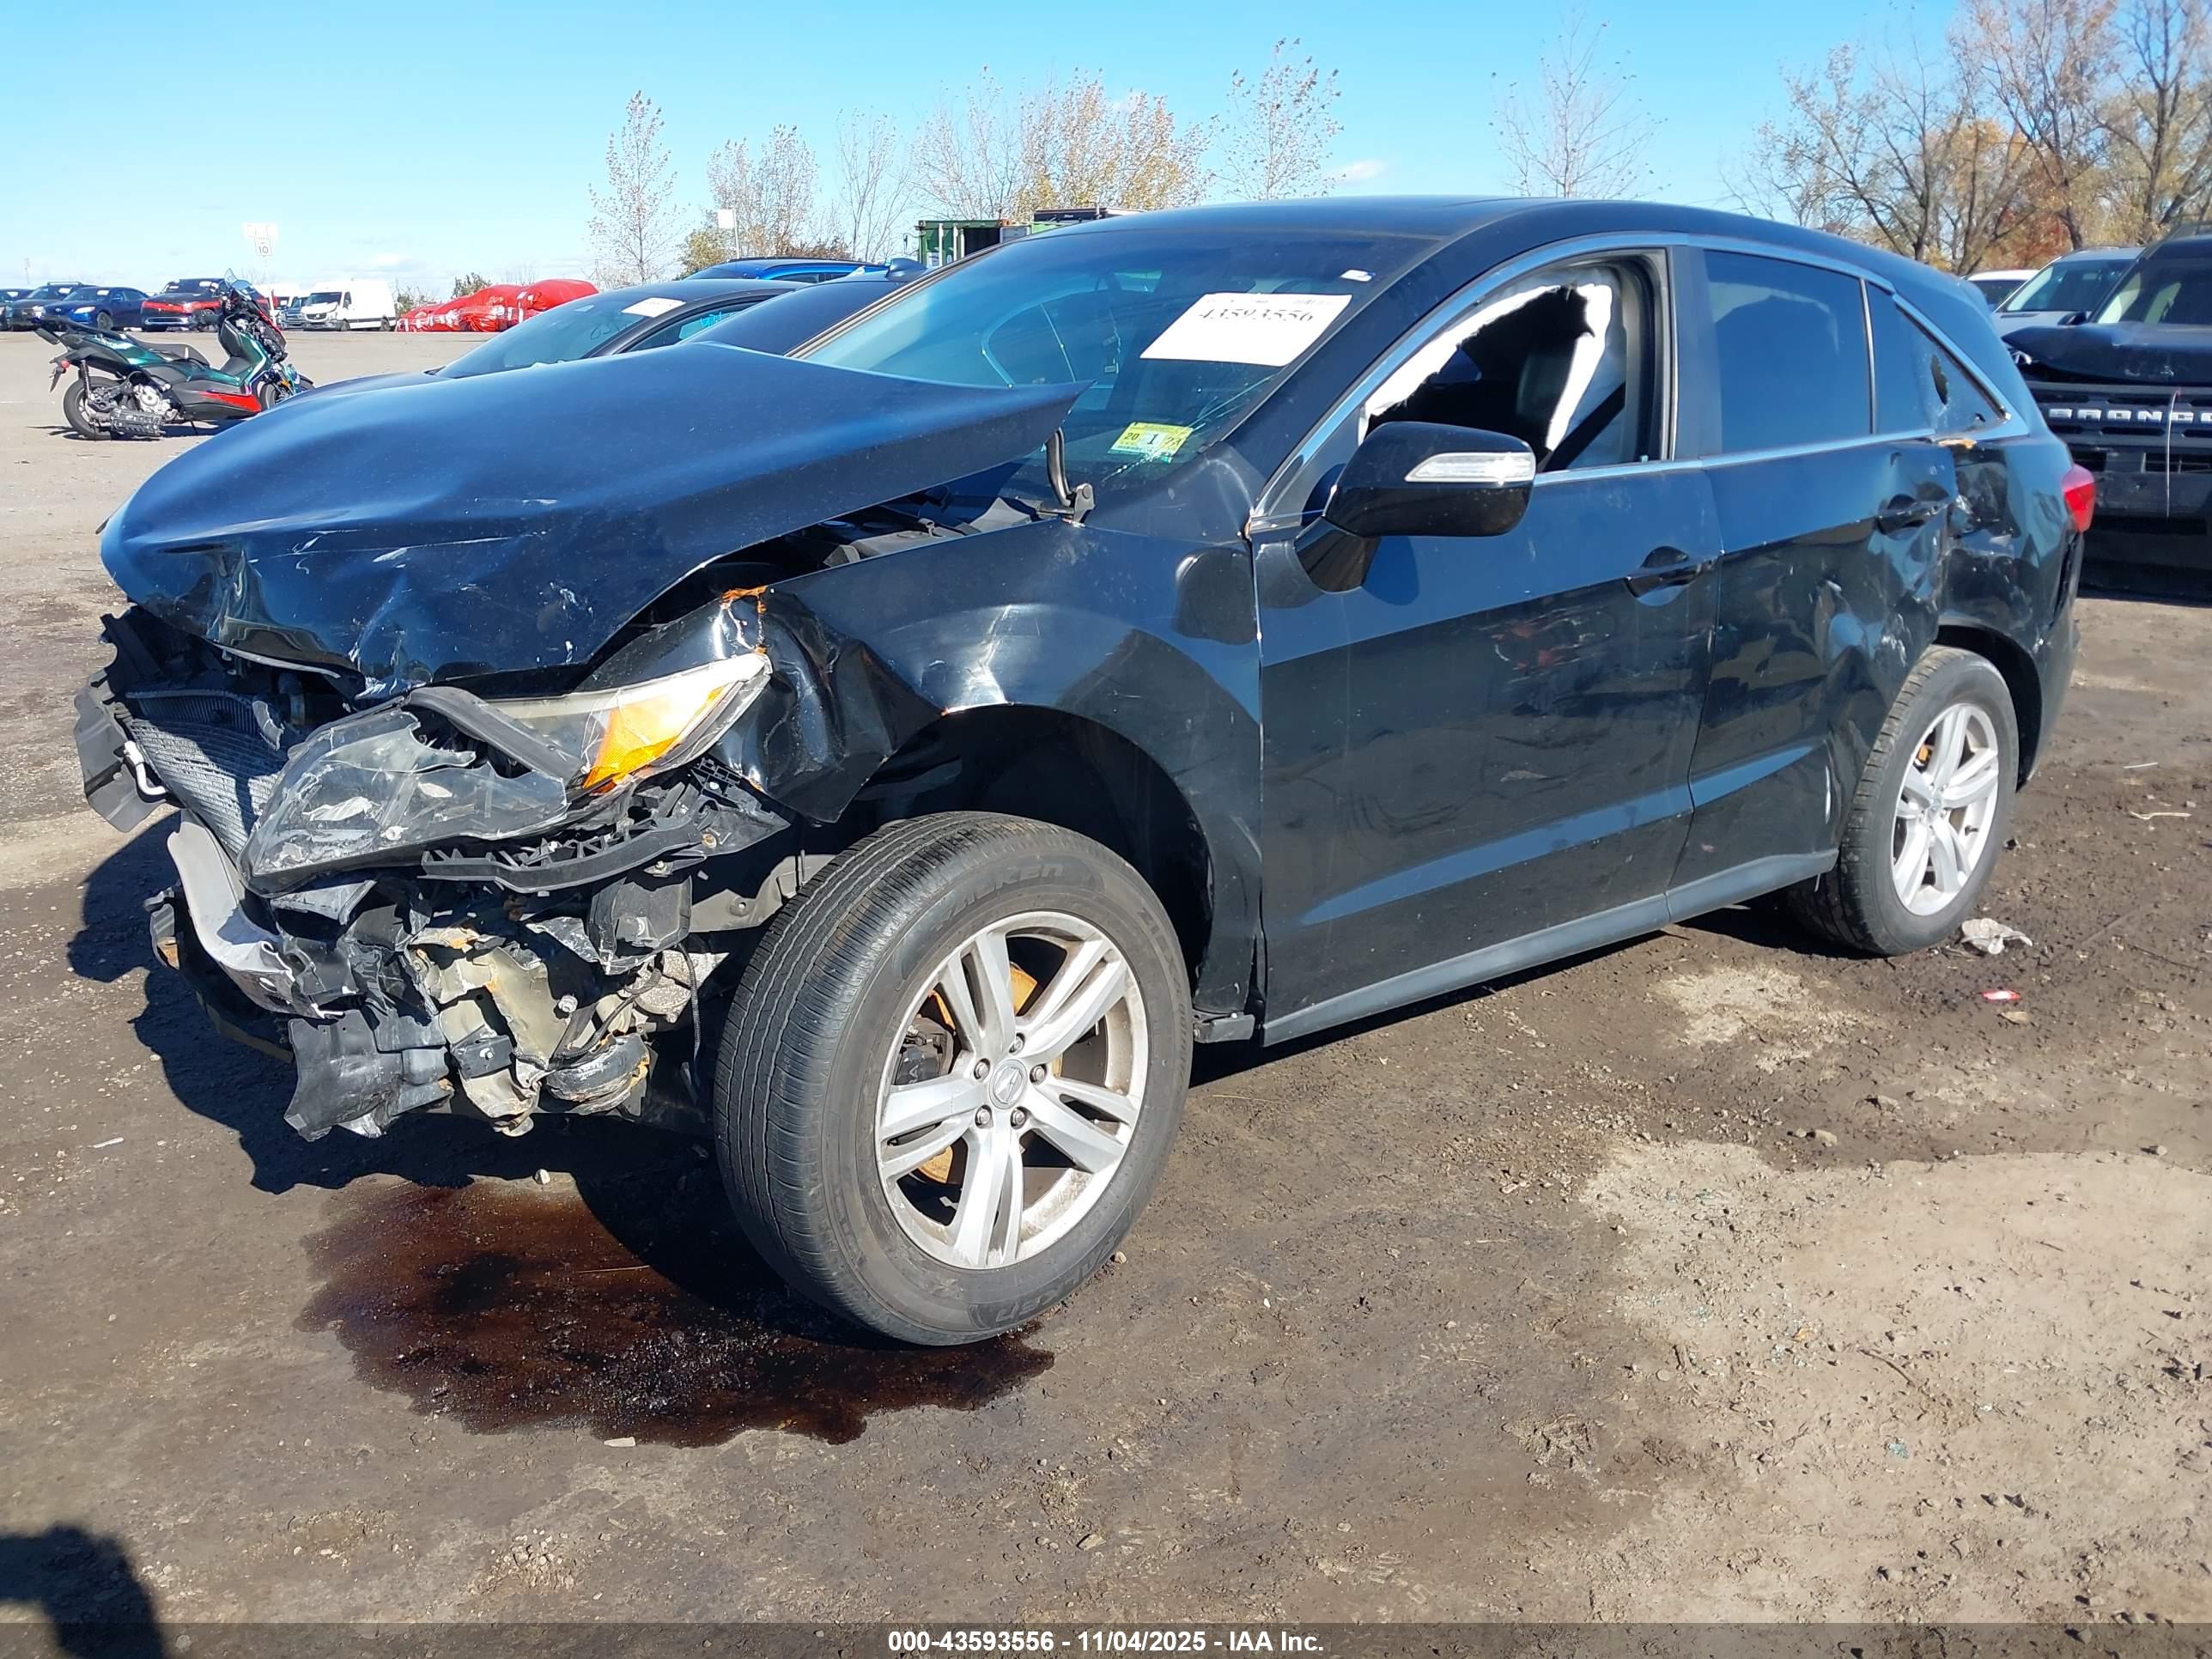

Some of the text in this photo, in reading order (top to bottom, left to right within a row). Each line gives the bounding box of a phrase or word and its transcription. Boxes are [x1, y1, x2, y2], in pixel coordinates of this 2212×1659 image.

[258, 246, 269, 254] 10
[1124, 432, 1140, 441] 20
[1146, 433, 1159, 445] 1
